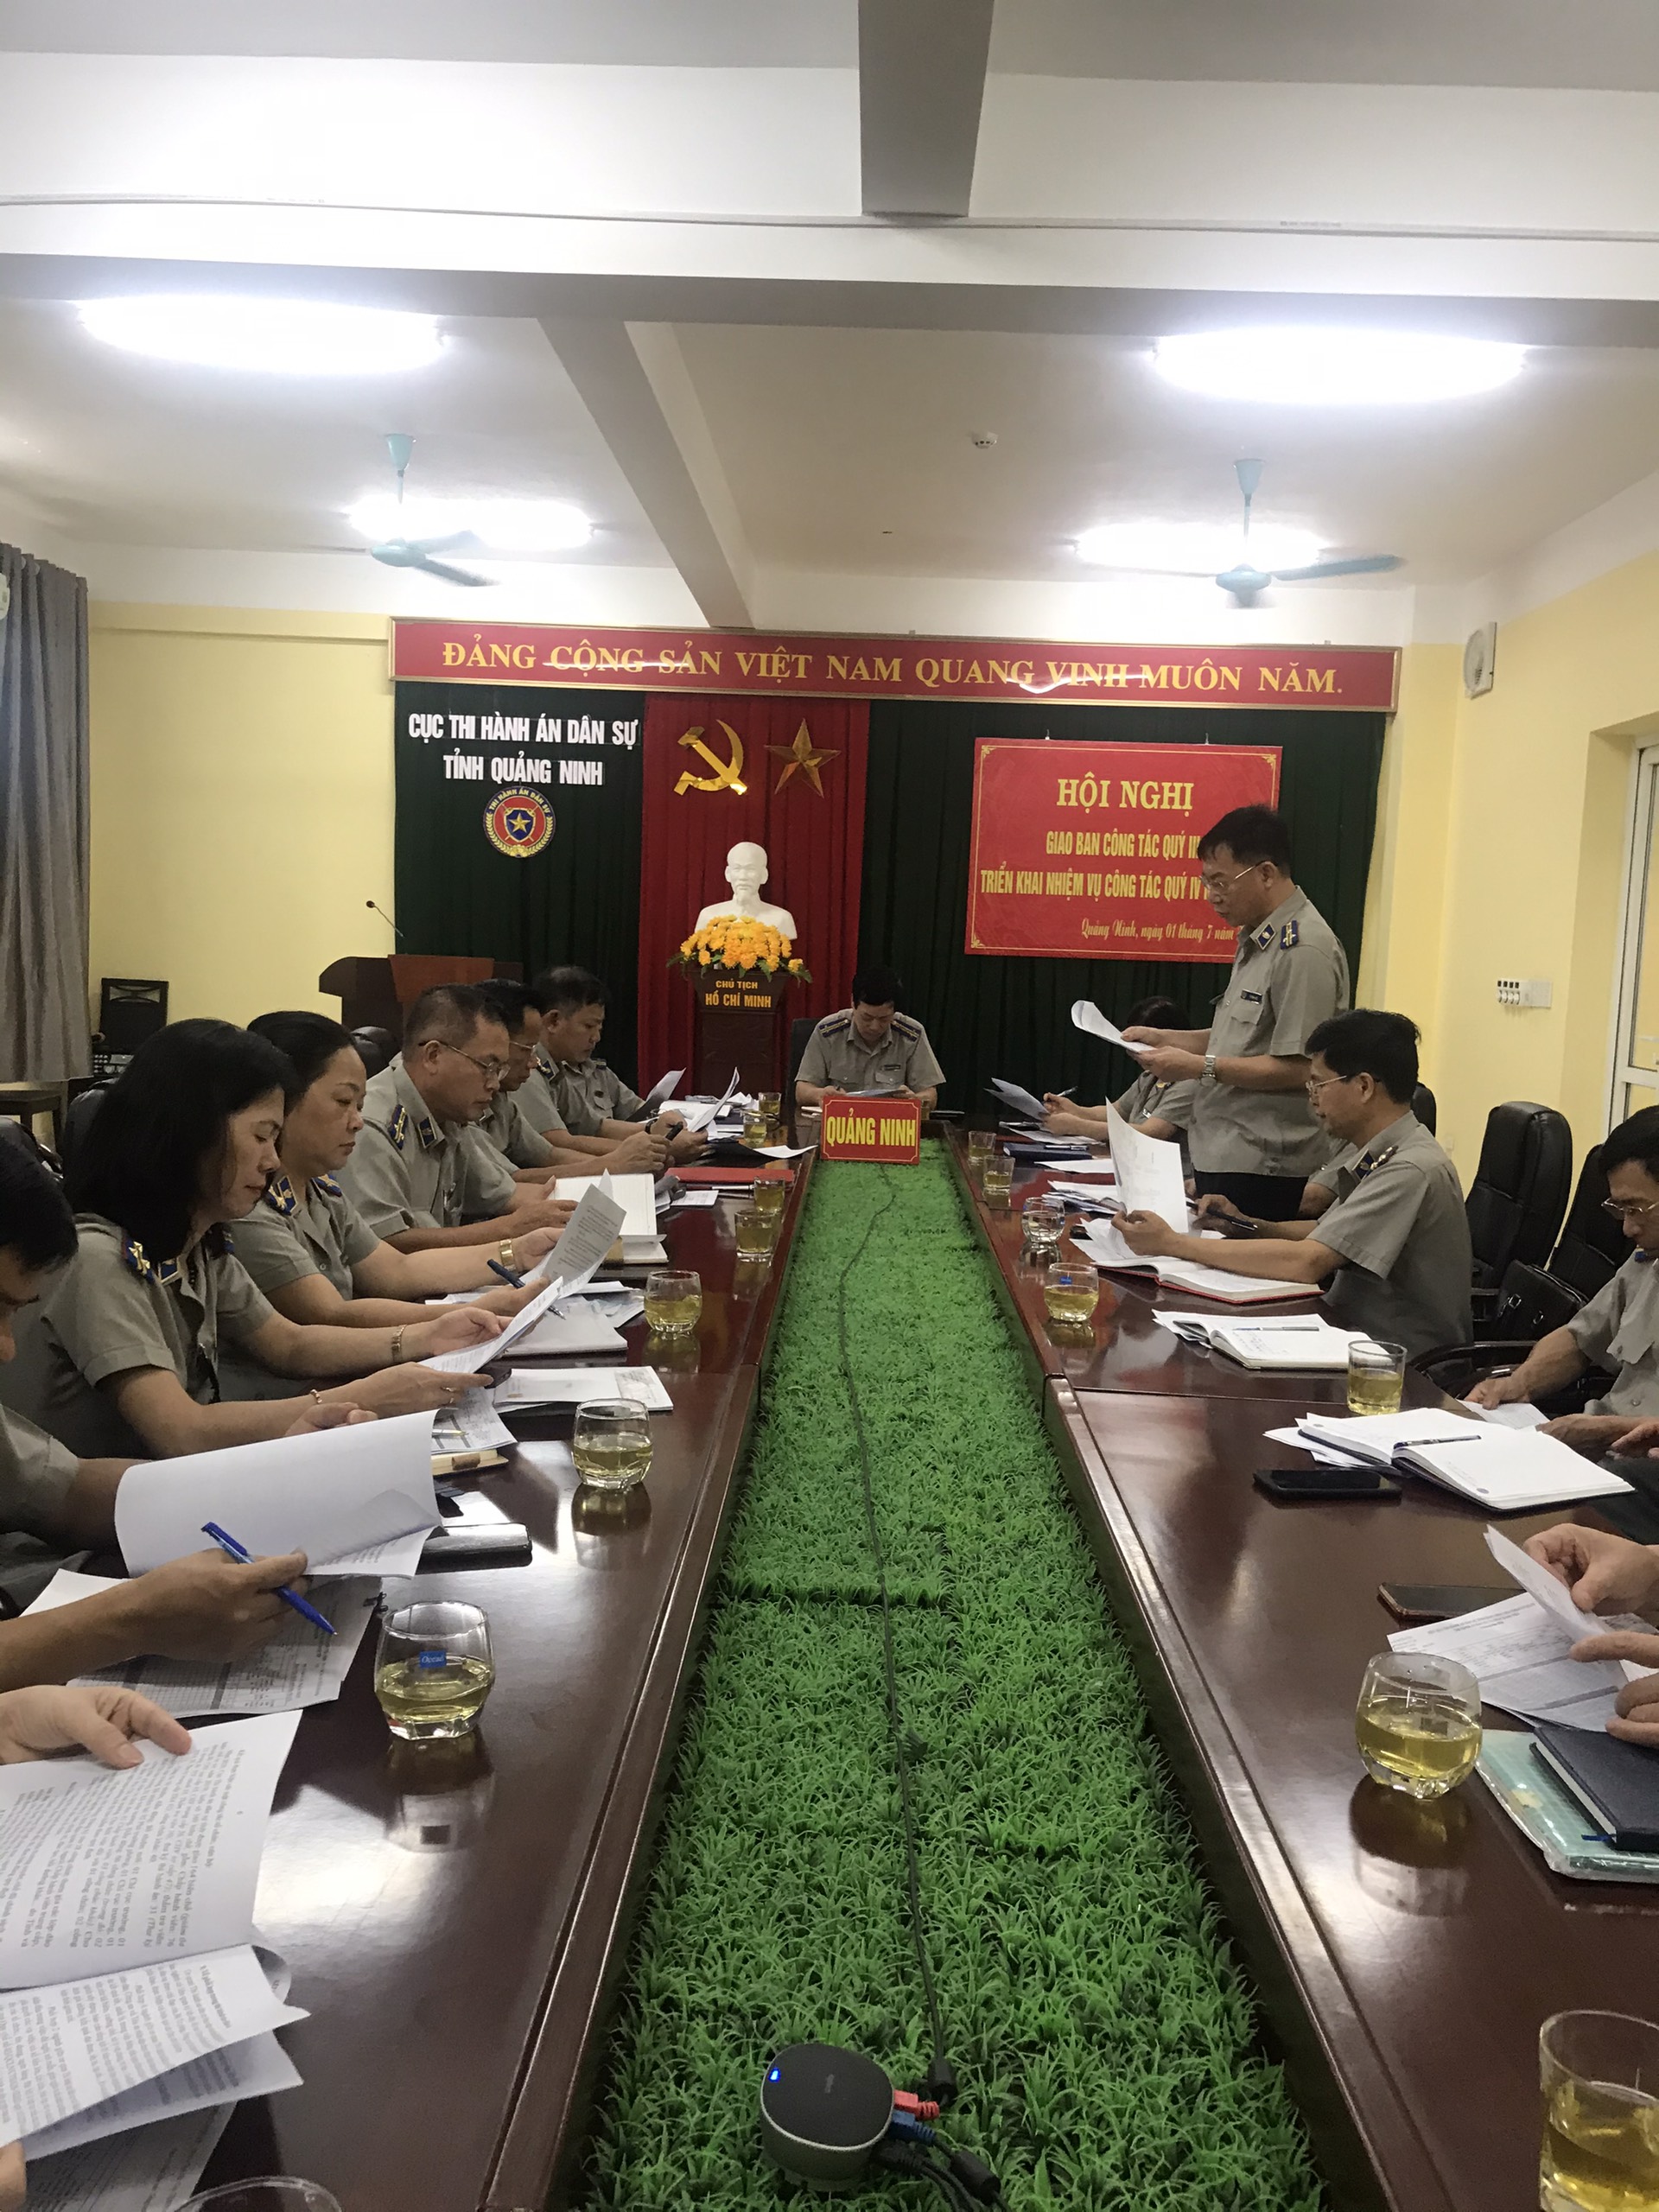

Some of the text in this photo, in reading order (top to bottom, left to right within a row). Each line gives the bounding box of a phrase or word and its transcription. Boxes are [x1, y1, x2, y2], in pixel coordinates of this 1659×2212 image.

[442, 633, 1343, 693] ĐẢNG CỘNG SẢN VIỆT NAM QUANG VINH MUÔN NĂM.
[408, 711, 639, 750] CỤC THI HÀNH ÁN DÂN SỰ
[443, 747, 603, 785] TỈNH QUẢNG NINH
[1056, 771, 1193, 817] HỘI NGHỊ
[1046, 830, 1073, 855] GIAO
[1076, 831, 1100, 855] BAN
[1103, 828, 1135, 857] CÔNG
[1138, 829, 1160, 858] TÁC
[1162, 830, 1185, 861] QUÝ
[980, 861, 1014, 893] TRIỂN
[1016, 870, 1043, 895] KHAI
[1046, 868, 1084, 901] NHIỆM
[1087, 873, 1102, 902] VỤ
[1104, 869, 1136, 899] CÔNG
[1139, 870, 1161, 899] TÁC
[1163, 871, 1187, 902] QUÝ
[1189, 876, 1202, 900] IV
[1081, 918, 1110, 941] Quảng
[1141, 924, 1164, 942] ngày
[1166, 923, 1177, 938] 01
[1178, 922, 1204, 944] tháng
[1206, 925, 1213, 940] 7
[1214, 926, 1235, 941] năm
[715, 978, 758, 991] CHỦ TỊCH
[722, 993, 741, 1007] CHÍ
[744, 995, 772, 1007] MINH
[827, 1107, 916, 1147] QUẢNG NINH
